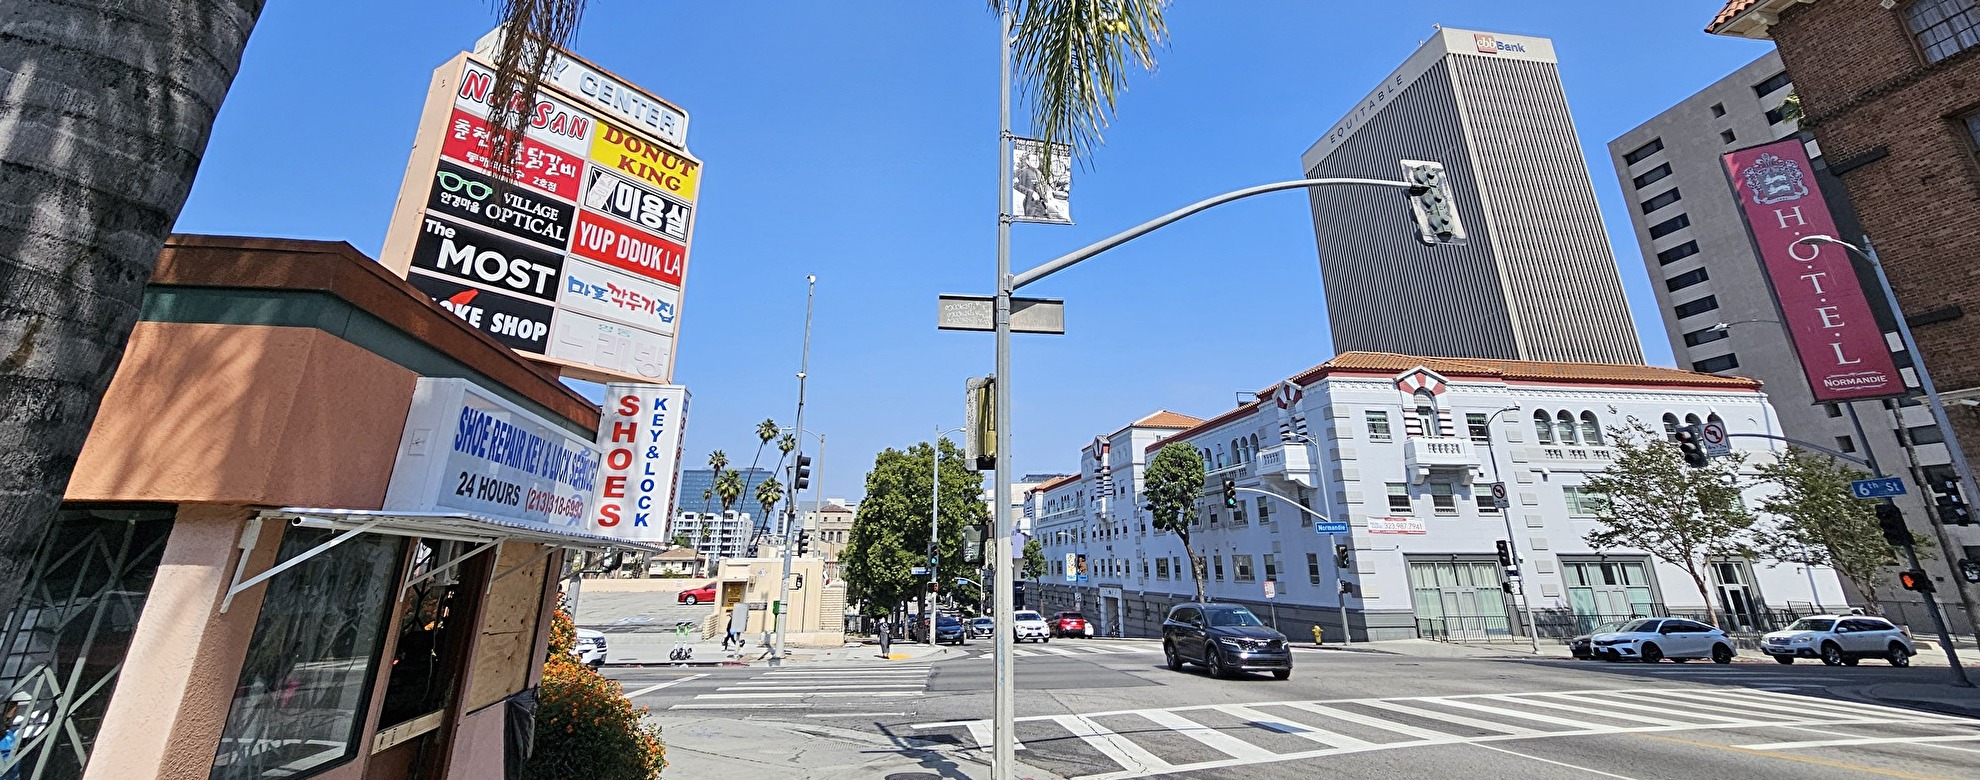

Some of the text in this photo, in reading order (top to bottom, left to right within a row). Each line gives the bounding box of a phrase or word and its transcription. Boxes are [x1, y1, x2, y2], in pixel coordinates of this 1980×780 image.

[580, 71, 676, 136] CENTER
[1329, 74, 1404, 144] EQUITABLE
[603, 125, 695, 177] DONUT
[617, 155, 682, 193] KING
[440, 191, 481, 214] 안경마을
[485, 203, 566, 242] OPTICAL
[504, 192, 560, 222] VILLAGE
[615, 181, 689, 239] 미용실
[425, 218, 456, 239] The
[579, 220, 682, 278] YUP DDUK LA
[436, 238, 556, 295] MOST
[490, 312, 548, 342] SHOP
[454, 405, 597, 492] SHOE REPAIR KEY & LOCK SERVICE
[598, 394, 641, 529] SHOES
[456, 471, 584, 520] 24 HOURS (213)318-6993
[1859, 481, 1901, 496] 6th St
[1317, 524, 1346, 532] Normandie
